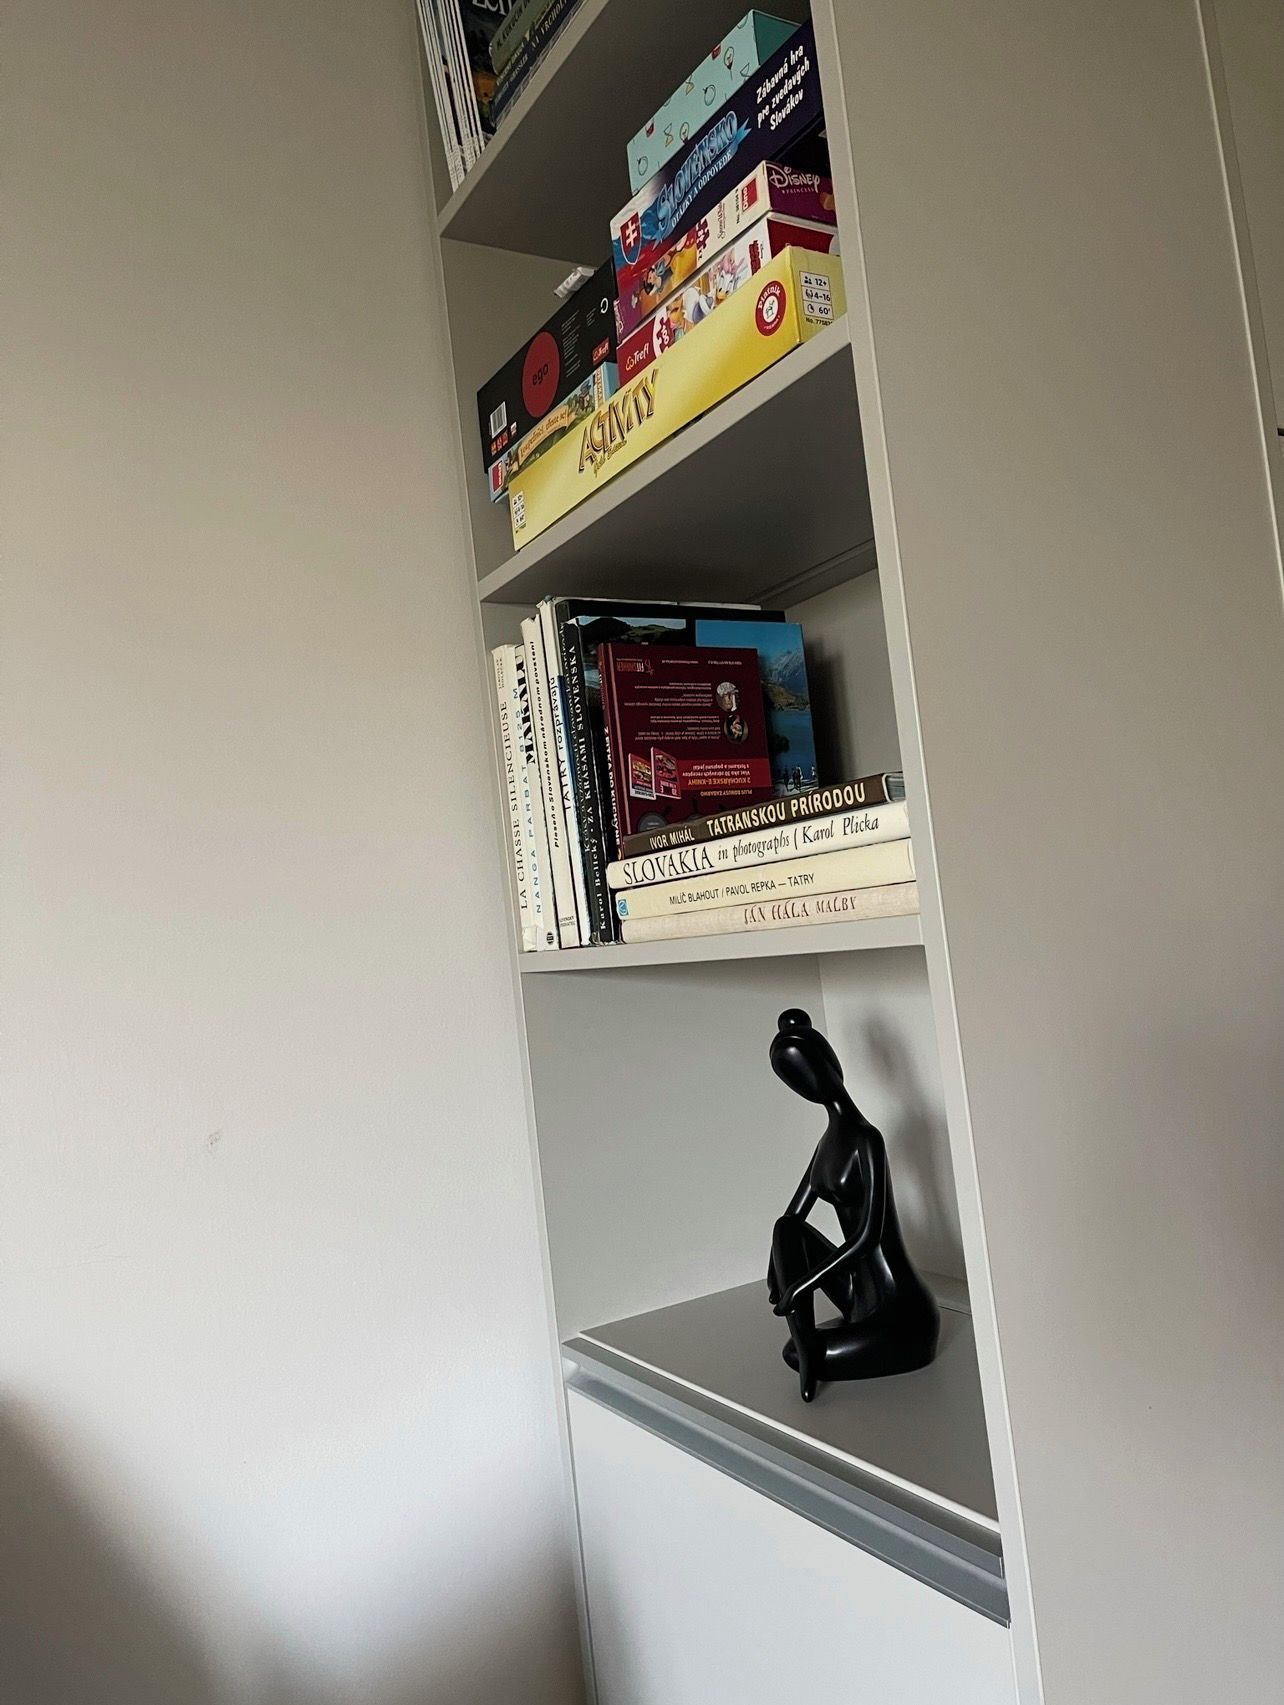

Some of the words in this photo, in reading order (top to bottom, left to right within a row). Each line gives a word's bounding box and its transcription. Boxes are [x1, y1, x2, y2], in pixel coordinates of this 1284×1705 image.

[756, 57, 788, 104] Zábavná
[790, 45, 804, 66] hra
[757, 105, 769, 129] pre
[771, 56, 810, 109] zvedavých
[770, 88, 804, 131] Slovákov
[698, 149, 732, 190] ODPOVEDE
[758, 285, 780, 309] Piatnik
[814, 278, 827, 286] 12+
[814, 292, 831, 302] 4-16
[532, 364, 549, 385] ego
[633, 343, 649, 364] Trefl
[578, 369, 660, 474] ACTIVITY
[514, 654, 536, 765] MAKALU
[537, 686, 547, 739] národnom
[568, 645, 585, 731] SLOVENSKA
[500, 701, 518, 811] SILENCIEUSE
[543, 741, 555, 803] Slovenskom
[578, 737, 592, 800] KRÁSAMI
[521, 764, 534, 838] PARBAT
[587, 805, 595, 824] ZA
[649, 834, 668, 850] IVOR
[669, 825, 695, 845] MIHÁL
[706, 802, 786, 837] TATRANSKOU
[790, 783, 866, 818] PRÍRODOU
[512, 819, 525, 882] CHASSE
[622, 846, 715, 885] SLOVAKIA
[718, 844, 728, 861] in
[732, 829, 790, 862] photographs
[802, 820, 835, 844] Karol
[842, 813, 880, 836] Plicka
[520, 889, 528, 910] LA
[530, 849, 541, 914] NANGA
[687, 888, 719, 903] BLAHOUT
[725, 884, 749, 897] PAVOL
[750, 879, 776, 893] REPKA
[787, 873, 815, 888] TATRY
[597, 892, 606, 930] Karol
[744, 904, 766, 925] JÁN
[771, 900, 809, 920] HÁLA
